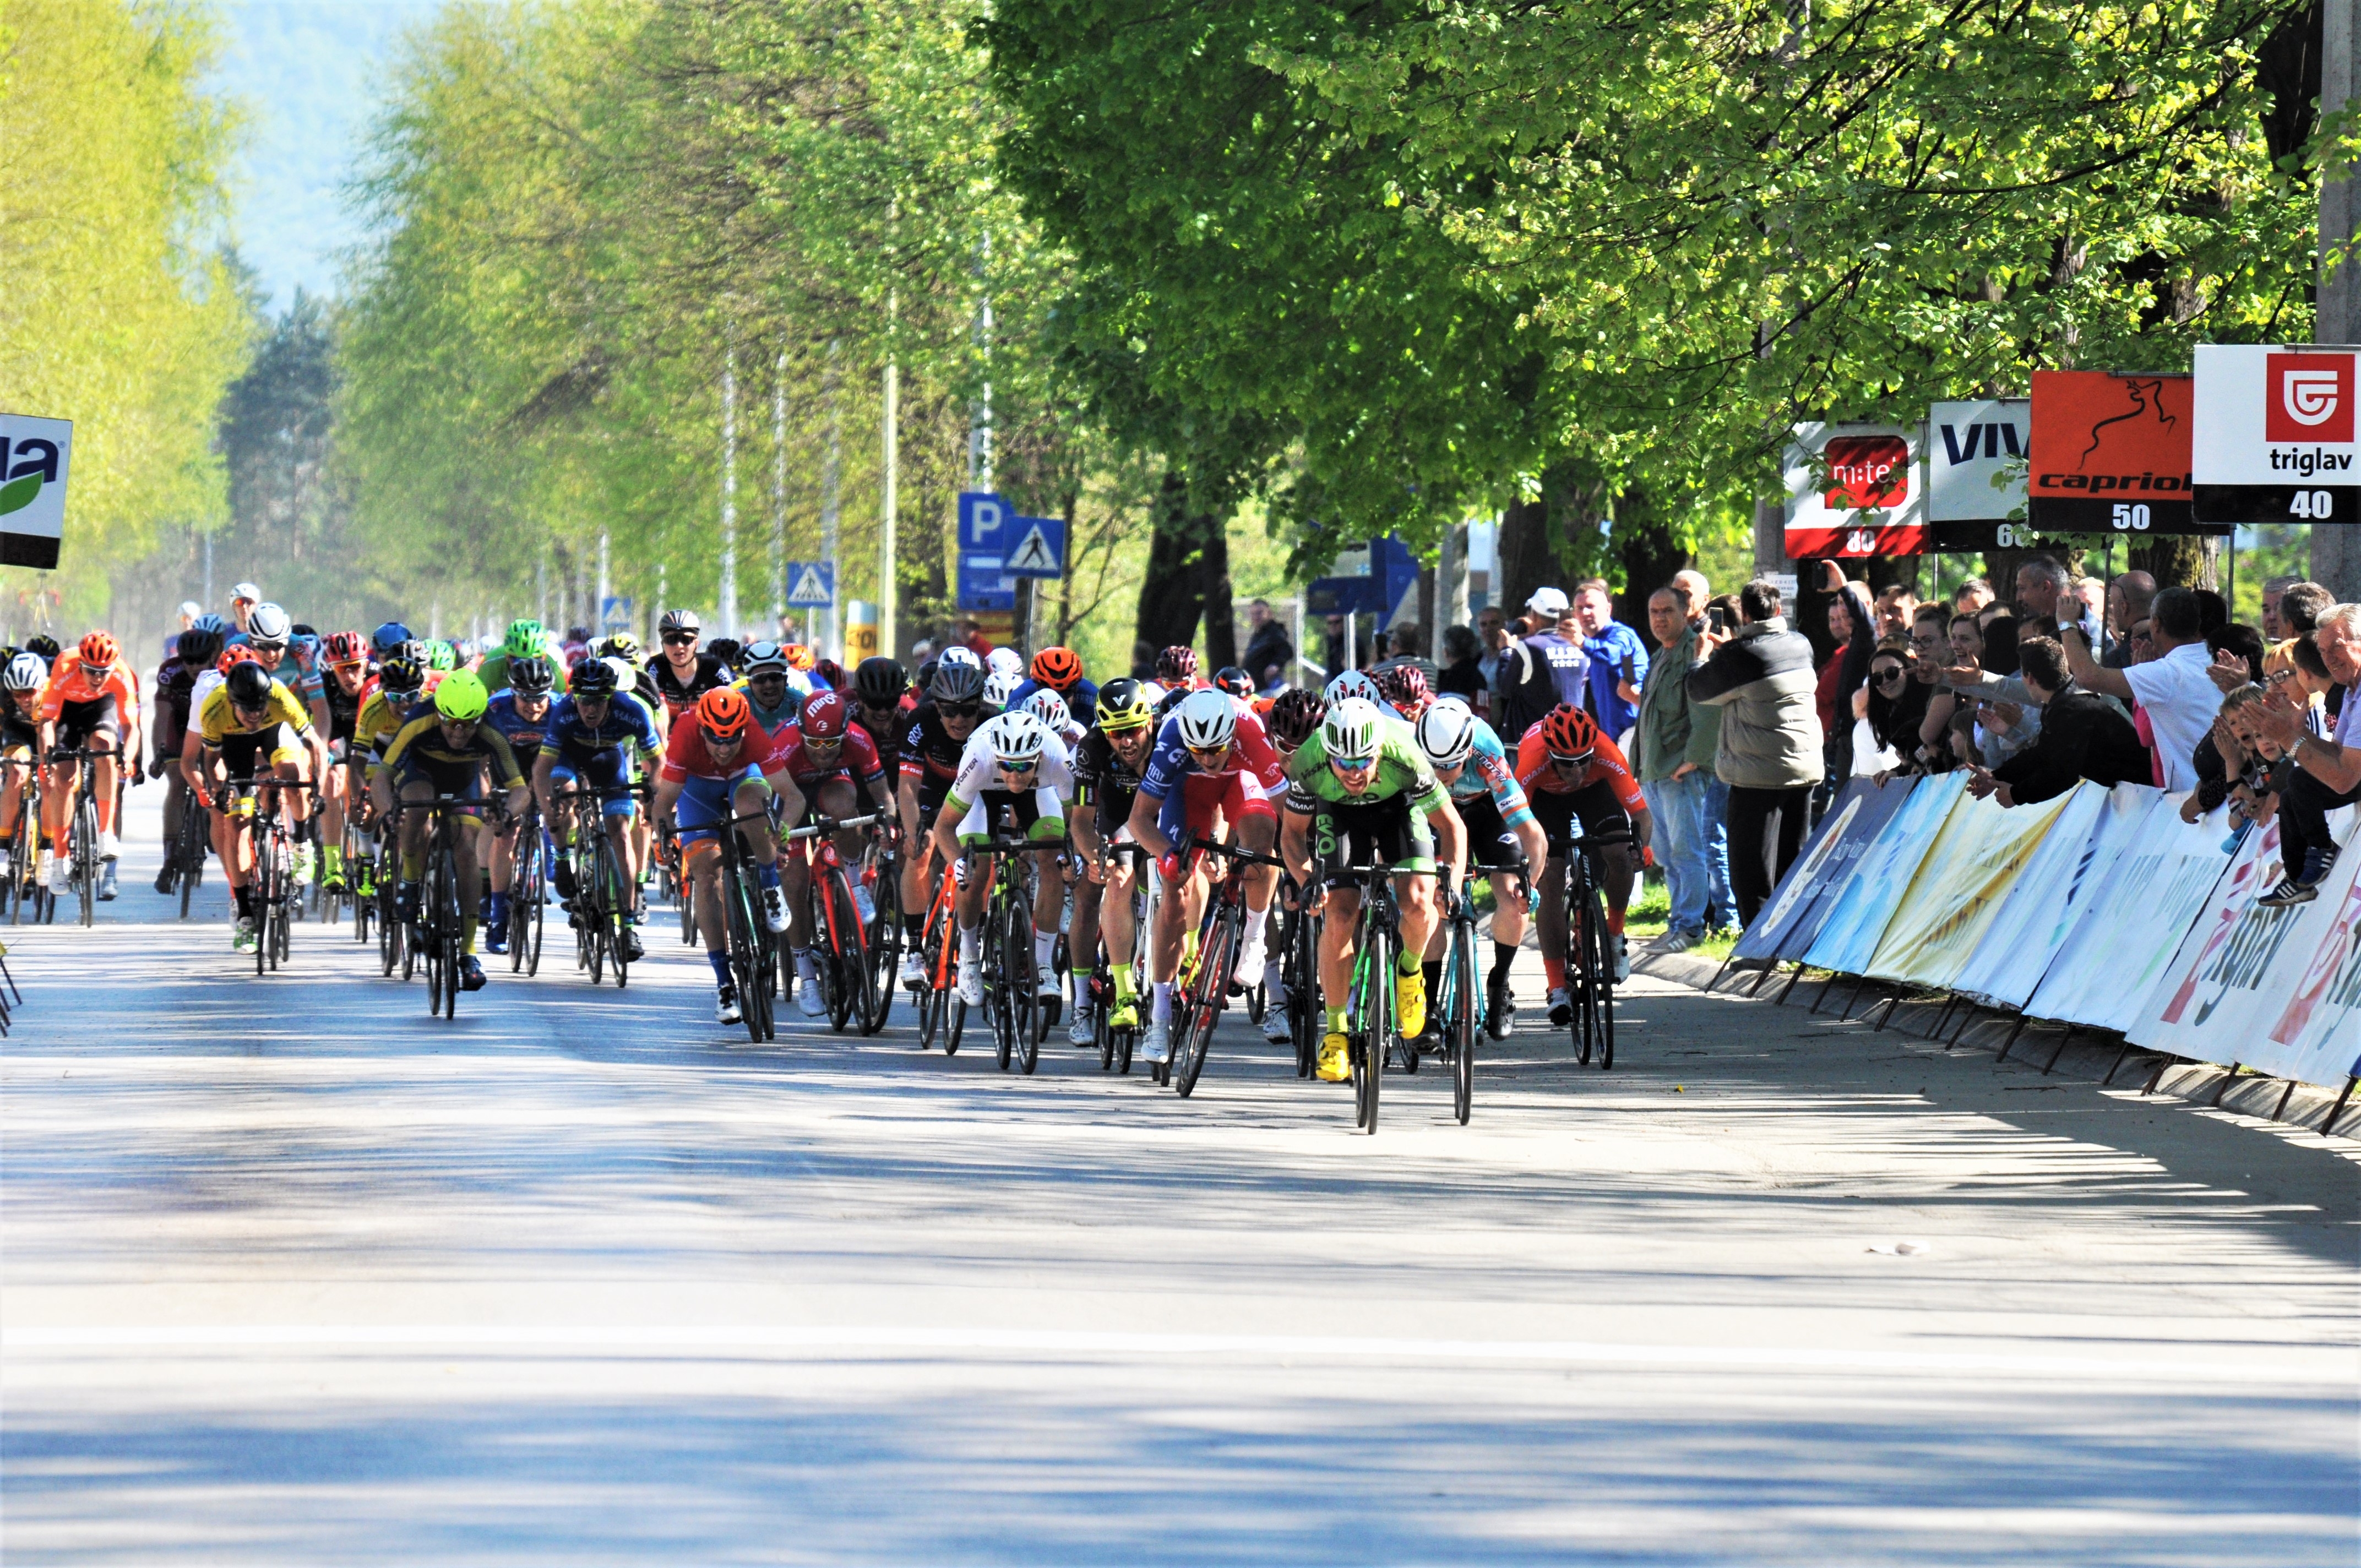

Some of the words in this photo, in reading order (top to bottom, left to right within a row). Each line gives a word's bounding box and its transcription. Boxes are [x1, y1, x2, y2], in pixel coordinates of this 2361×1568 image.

[2270, 447, 2353, 477] triglav
[2039, 472, 2192, 493] capriol
[2113, 504, 2150, 530] 50
[2289, 491, 2332, 519] 40
[972, 500, 1002, 543] P
[1846, 530, 1875, 552] 80
[956, 758, 978, 787] VOSTER
[1147, 762, 1166, 782] FIAT
[1521, 760, 1550, 785] GIANT
[1597, 758, 1626, 776] GIANT
[1316, 813, 1336, 854] EVO
